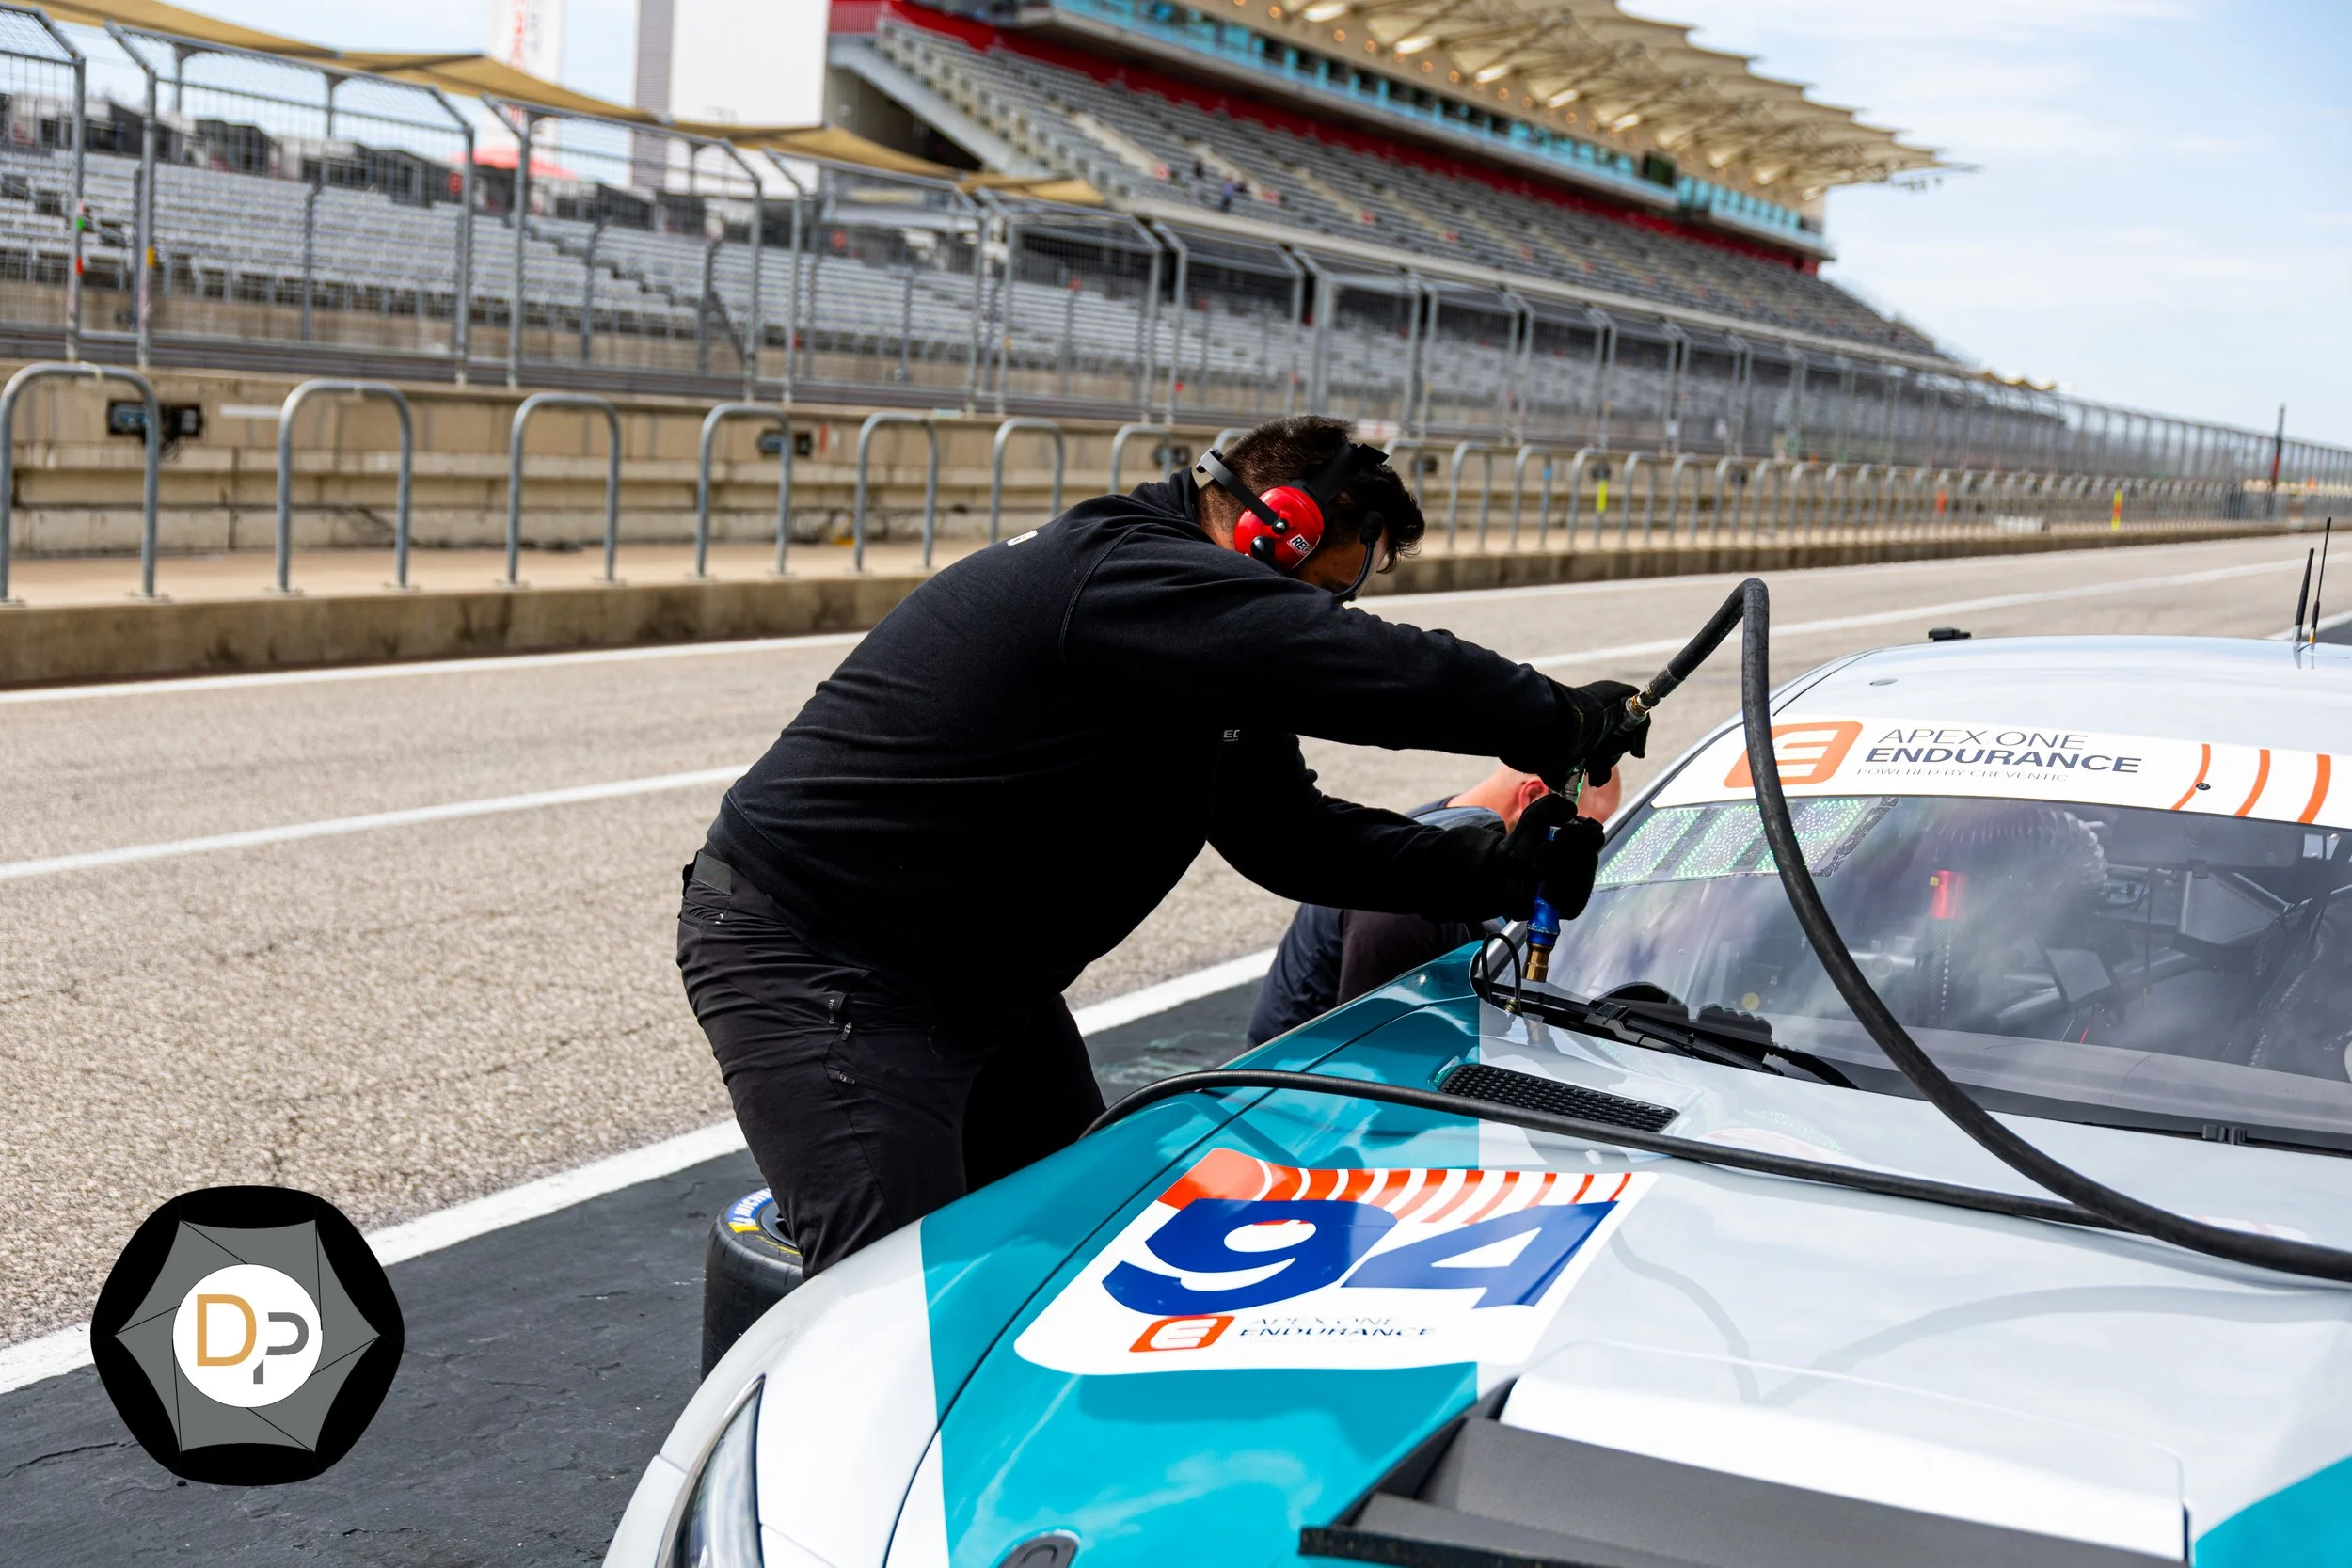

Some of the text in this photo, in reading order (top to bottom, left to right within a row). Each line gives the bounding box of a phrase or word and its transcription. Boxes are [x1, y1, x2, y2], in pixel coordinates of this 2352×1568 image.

[1877, 728, 2090, 751] APEX ONE
[1864, 747, 2142, 774] ENDURANCE
[1856, 767, 2070, 783] POWERED BY CREVENTIC
[1101, 1197, 1620, 1315] 94
[1238, 1326, 1437, 1337] ENDURANCE
